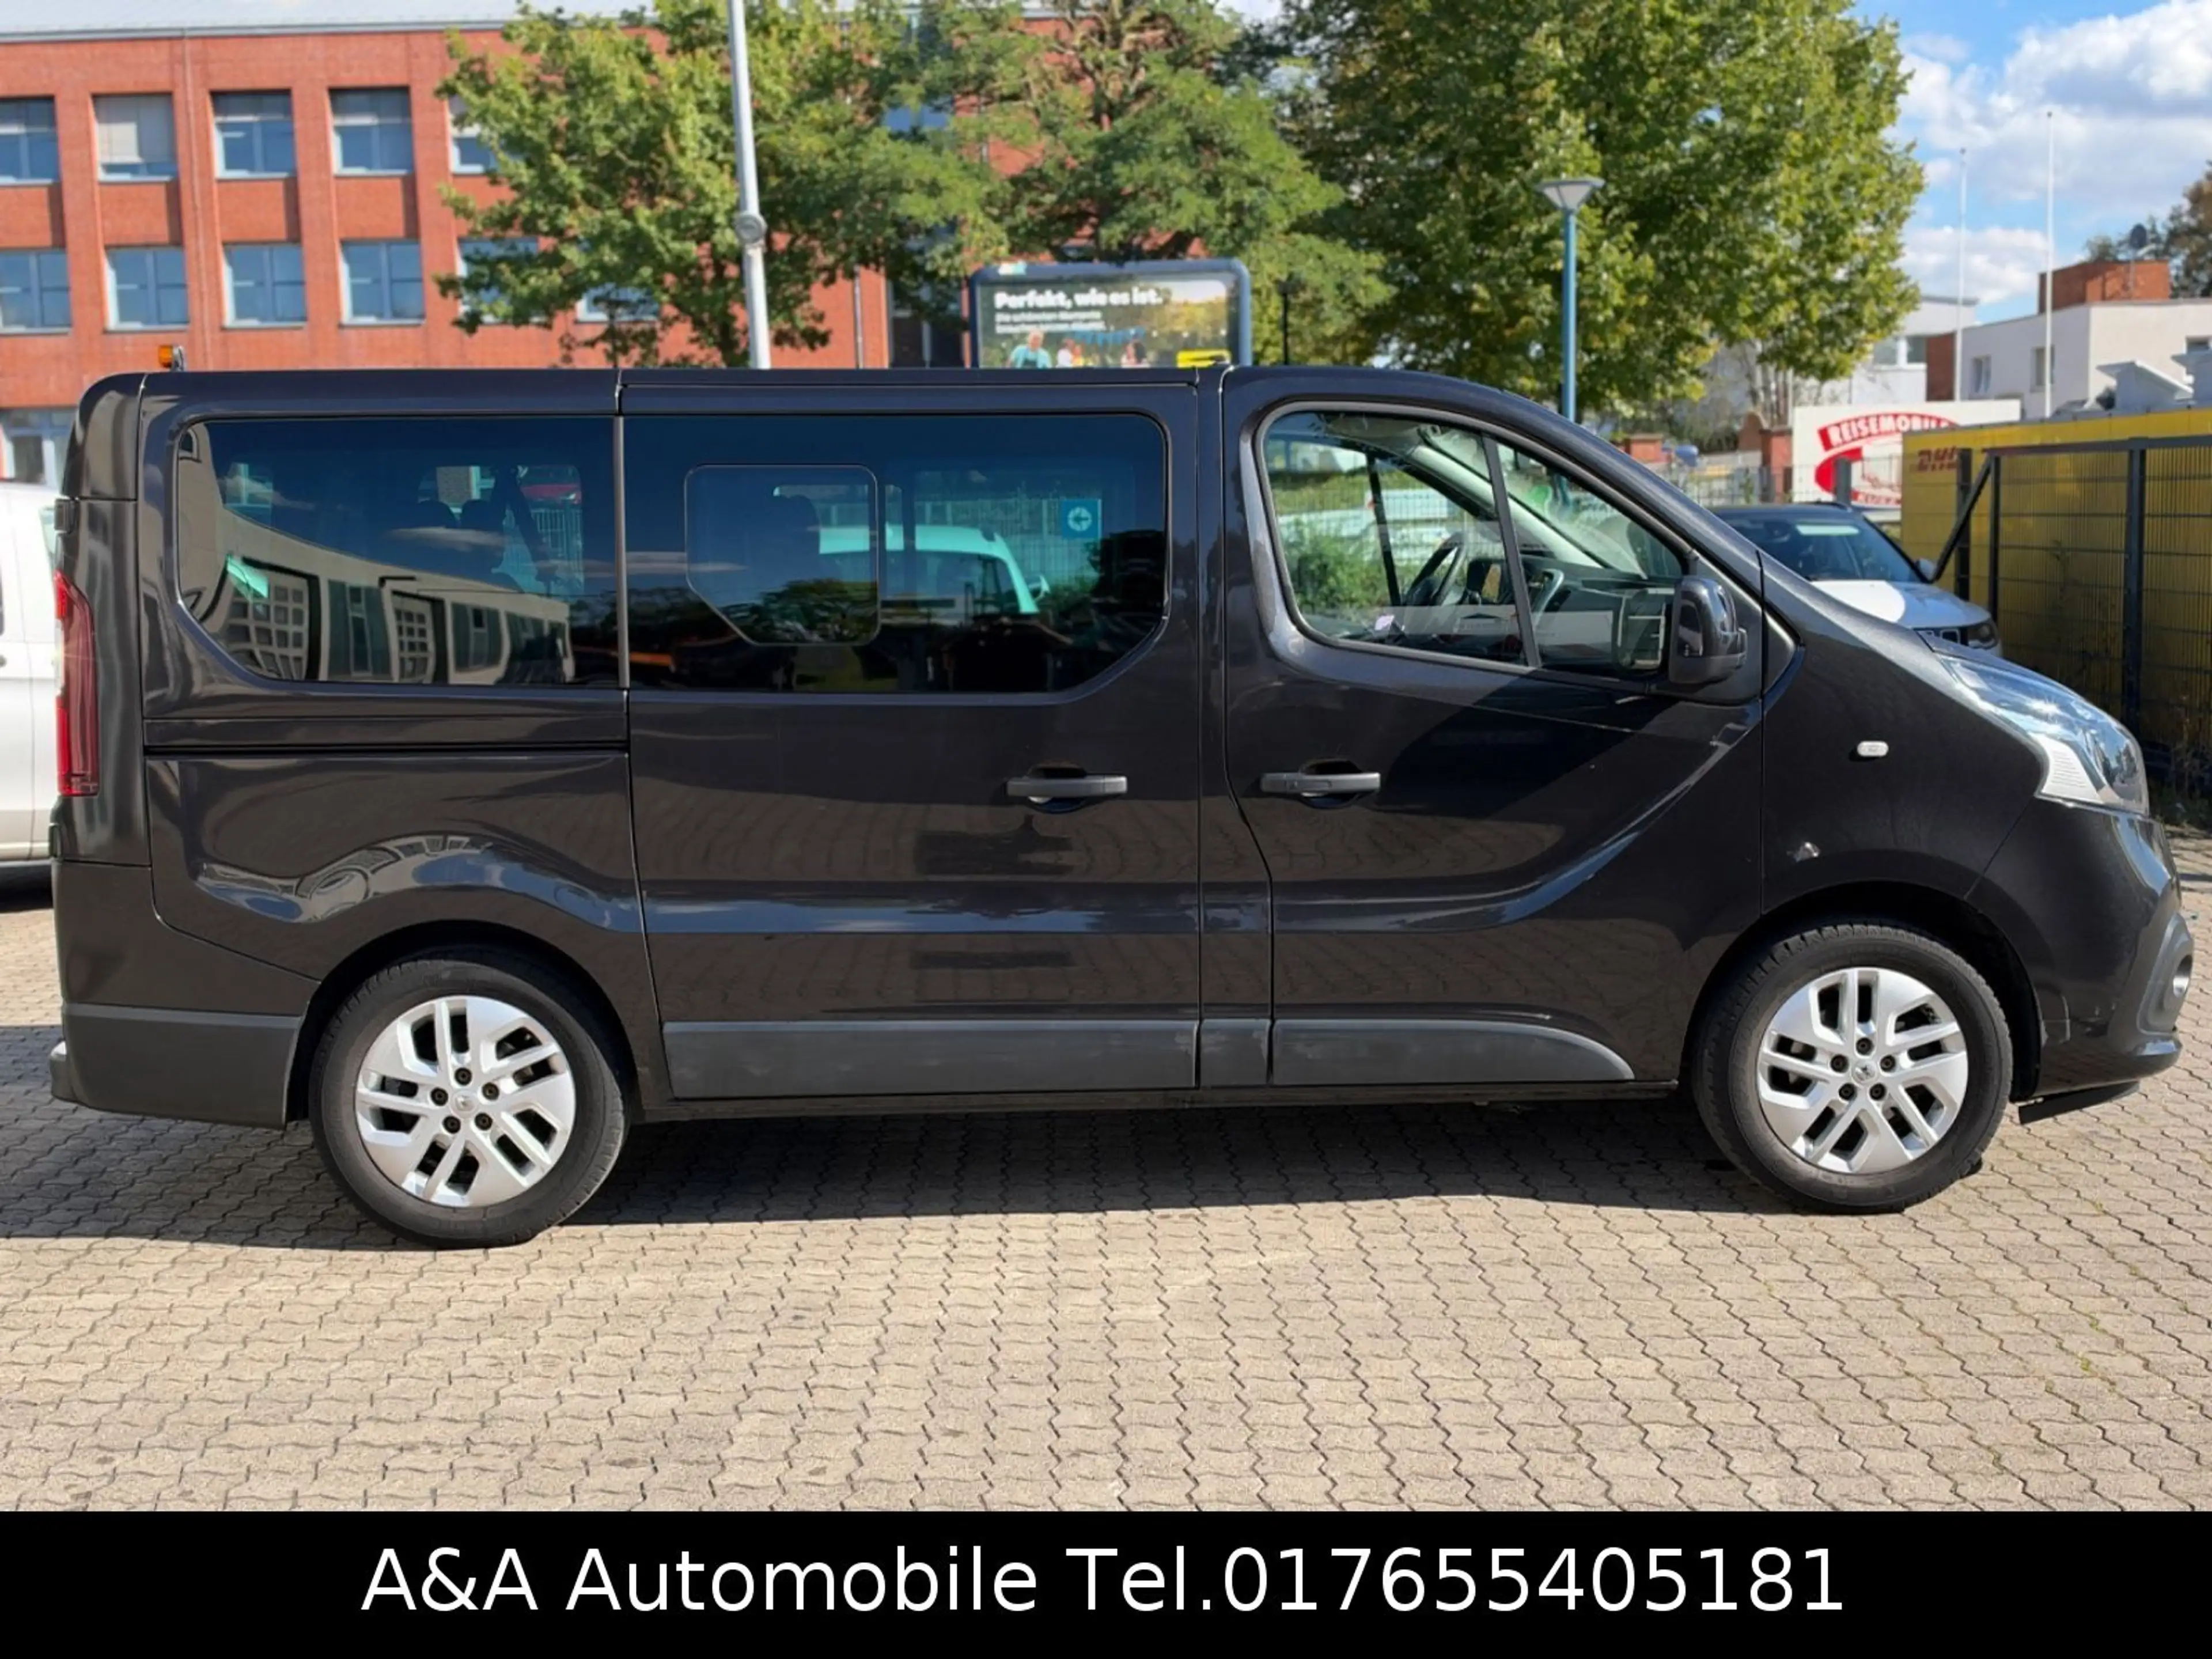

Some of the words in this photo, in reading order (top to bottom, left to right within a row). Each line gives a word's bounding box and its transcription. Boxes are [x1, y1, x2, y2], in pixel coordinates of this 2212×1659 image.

[995, 290, 1072, 309] Perfekt,
[1074, 288, 1107, 306] wie
[1109, 293, 1130, 305] es
